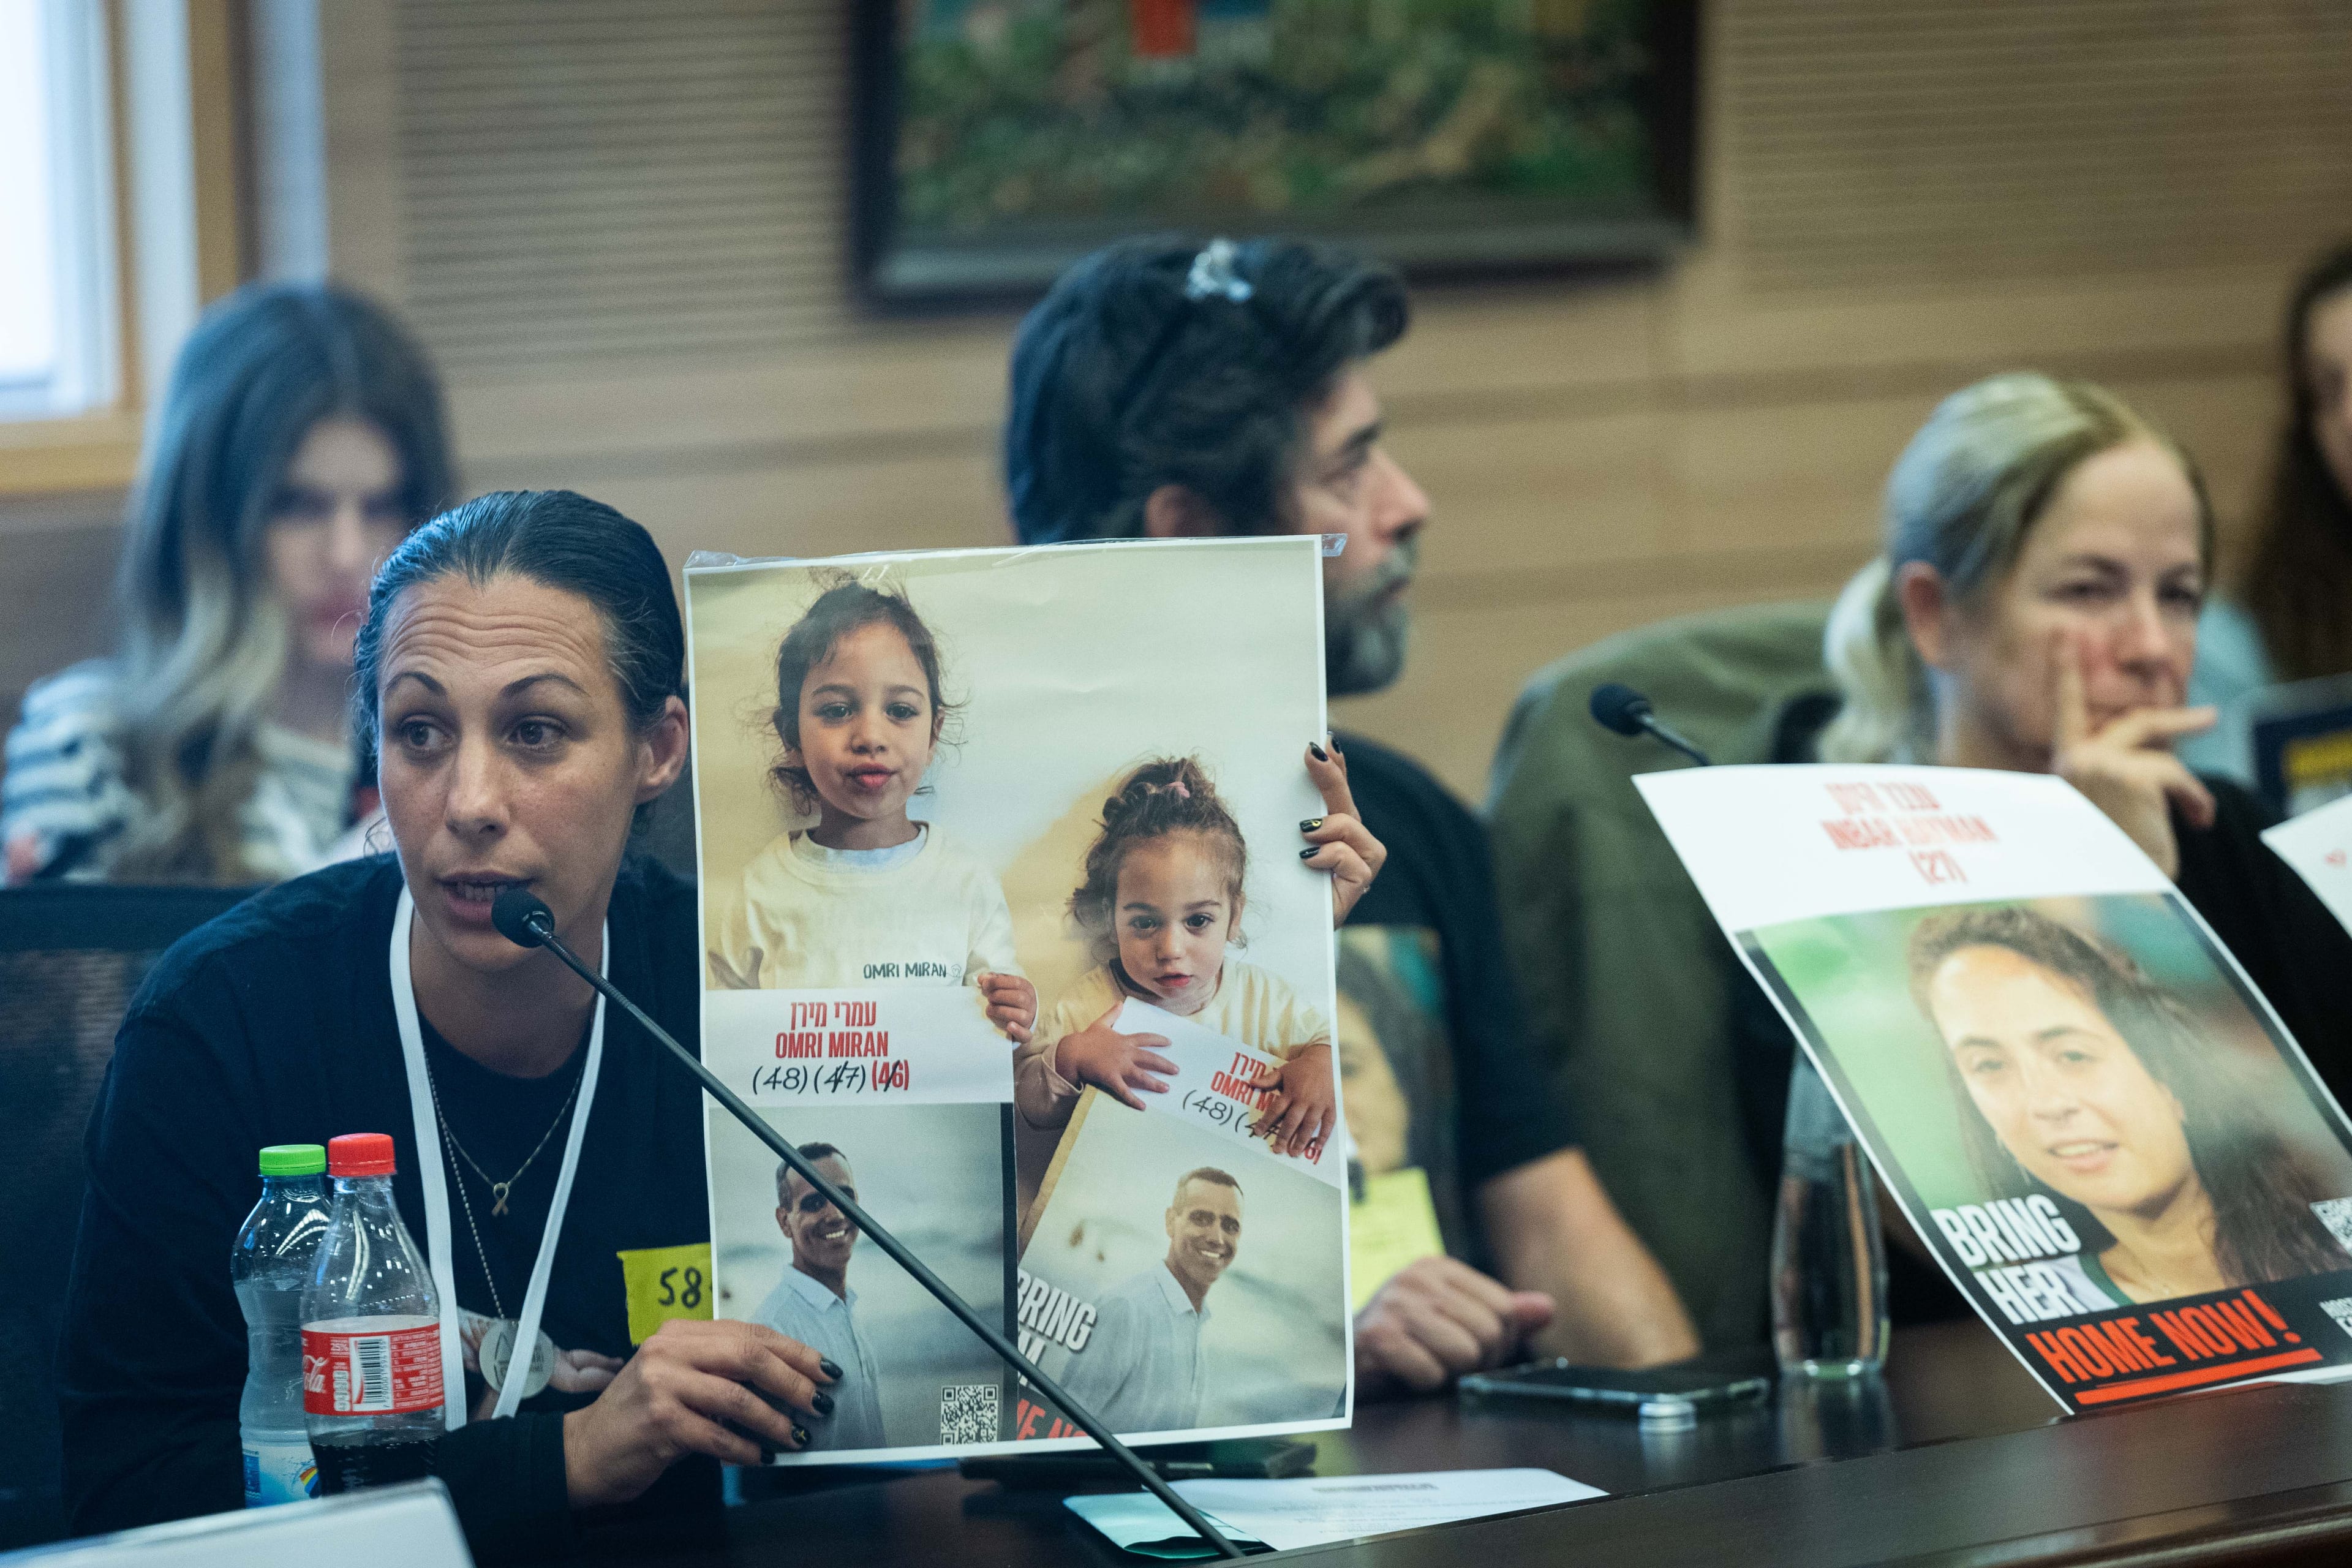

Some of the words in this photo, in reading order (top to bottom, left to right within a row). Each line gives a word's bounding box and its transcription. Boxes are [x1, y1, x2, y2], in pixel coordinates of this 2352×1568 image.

[864, 963, 899, 979] OMRI
[905, 962, 946, 978] MIRAN
[791, 1002, 827, 1030] מירן
[835, 1001, 876, 1027] עמרי
[775, 1032, 822, 1058] OMRI
[829, 1031, 888, 1058] MIRAN
[753, 1066, 807, 1095] (48)
[872, 1060, 909, 1091] (46)
[1211, 1071, 1254, 1105] OMRI
[1183, 1089, 1234, 1126] (48)
[1930, 1194, 2081, 1267] BRING
[658, 1266, 702, 1310] 58
[1974, 1261, 2087, 1324] HER
[2026, 1317, 2177, 1384] HOME
[2149, 1289, 2302, 1360] NOW!
